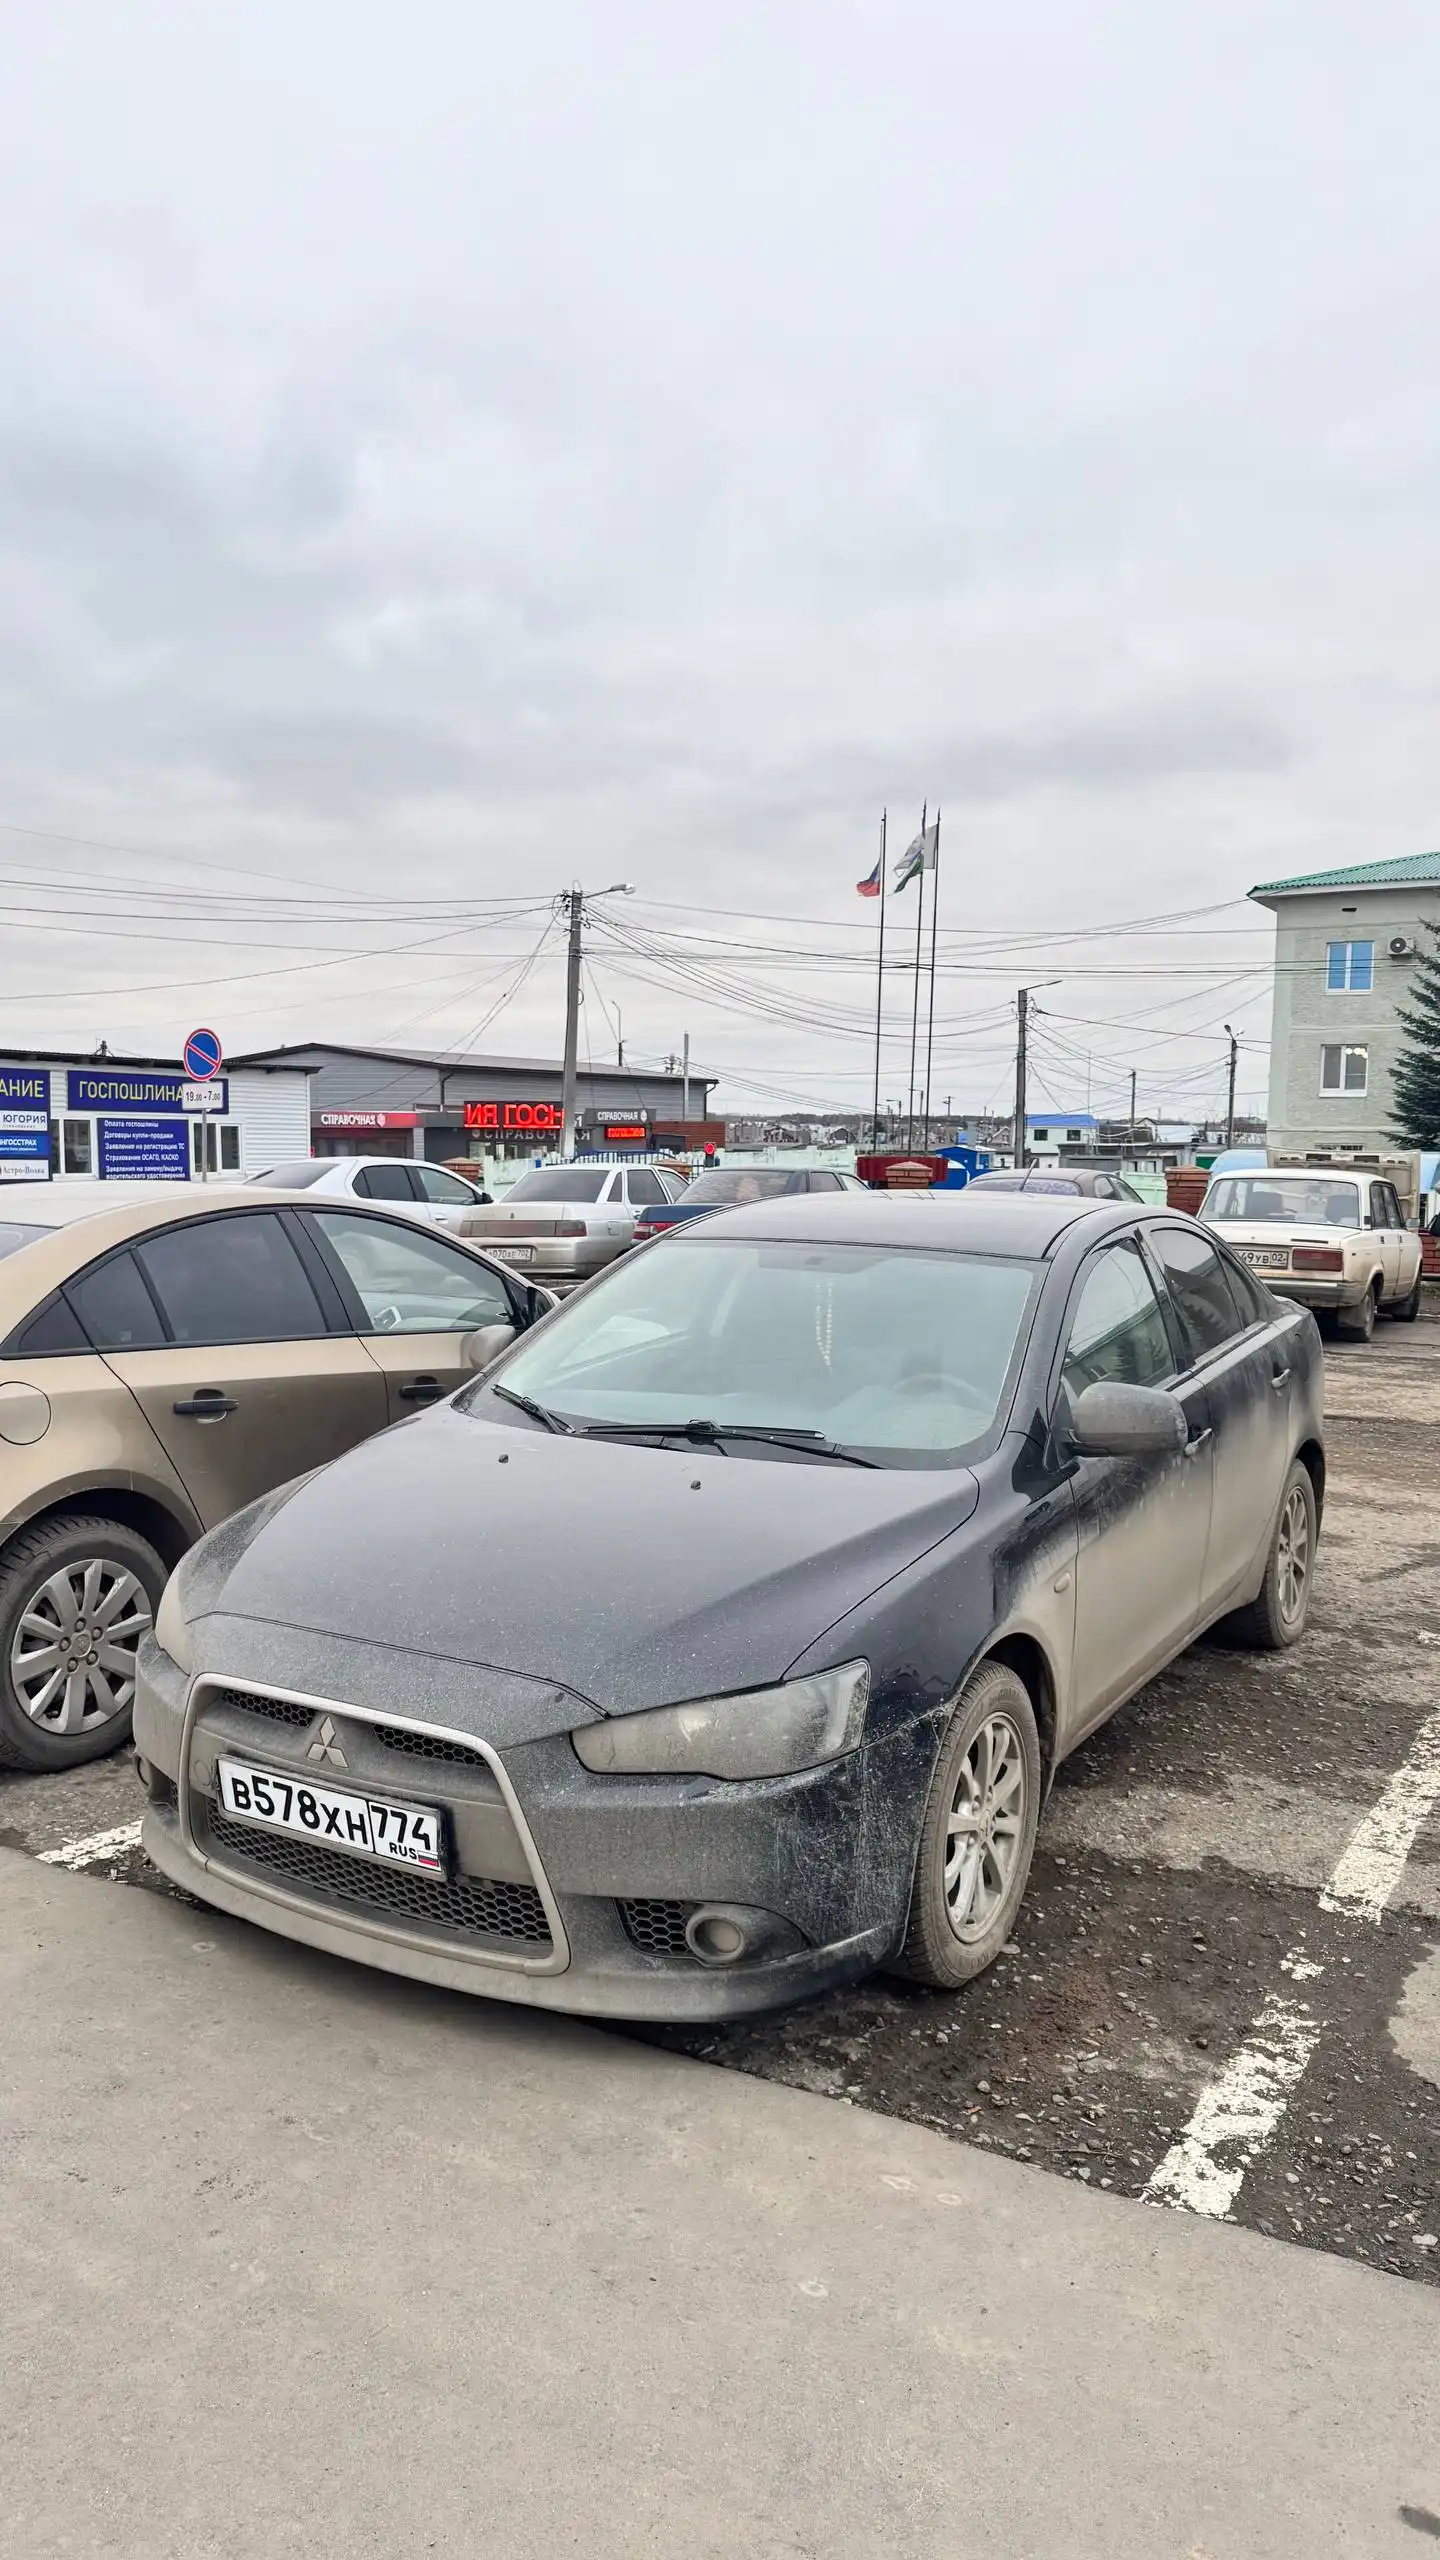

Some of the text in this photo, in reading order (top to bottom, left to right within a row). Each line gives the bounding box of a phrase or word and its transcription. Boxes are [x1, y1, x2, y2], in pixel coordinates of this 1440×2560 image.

[79, 1080, 183, 1101] ГОСПОШЛИНА
[3, 1114, 46, 1123] ЮГОРИЯ
[320, 1113, 376, 1125] СПРАВОЧНАЯ
[597, 1111, 638, 1121] СПРАВОЧНАЯ
[104, 1120, 125, 1128] Оплата
[104, 1131, 132, 1140] Договоры
[388, 1841, 418, 1861] RUS
